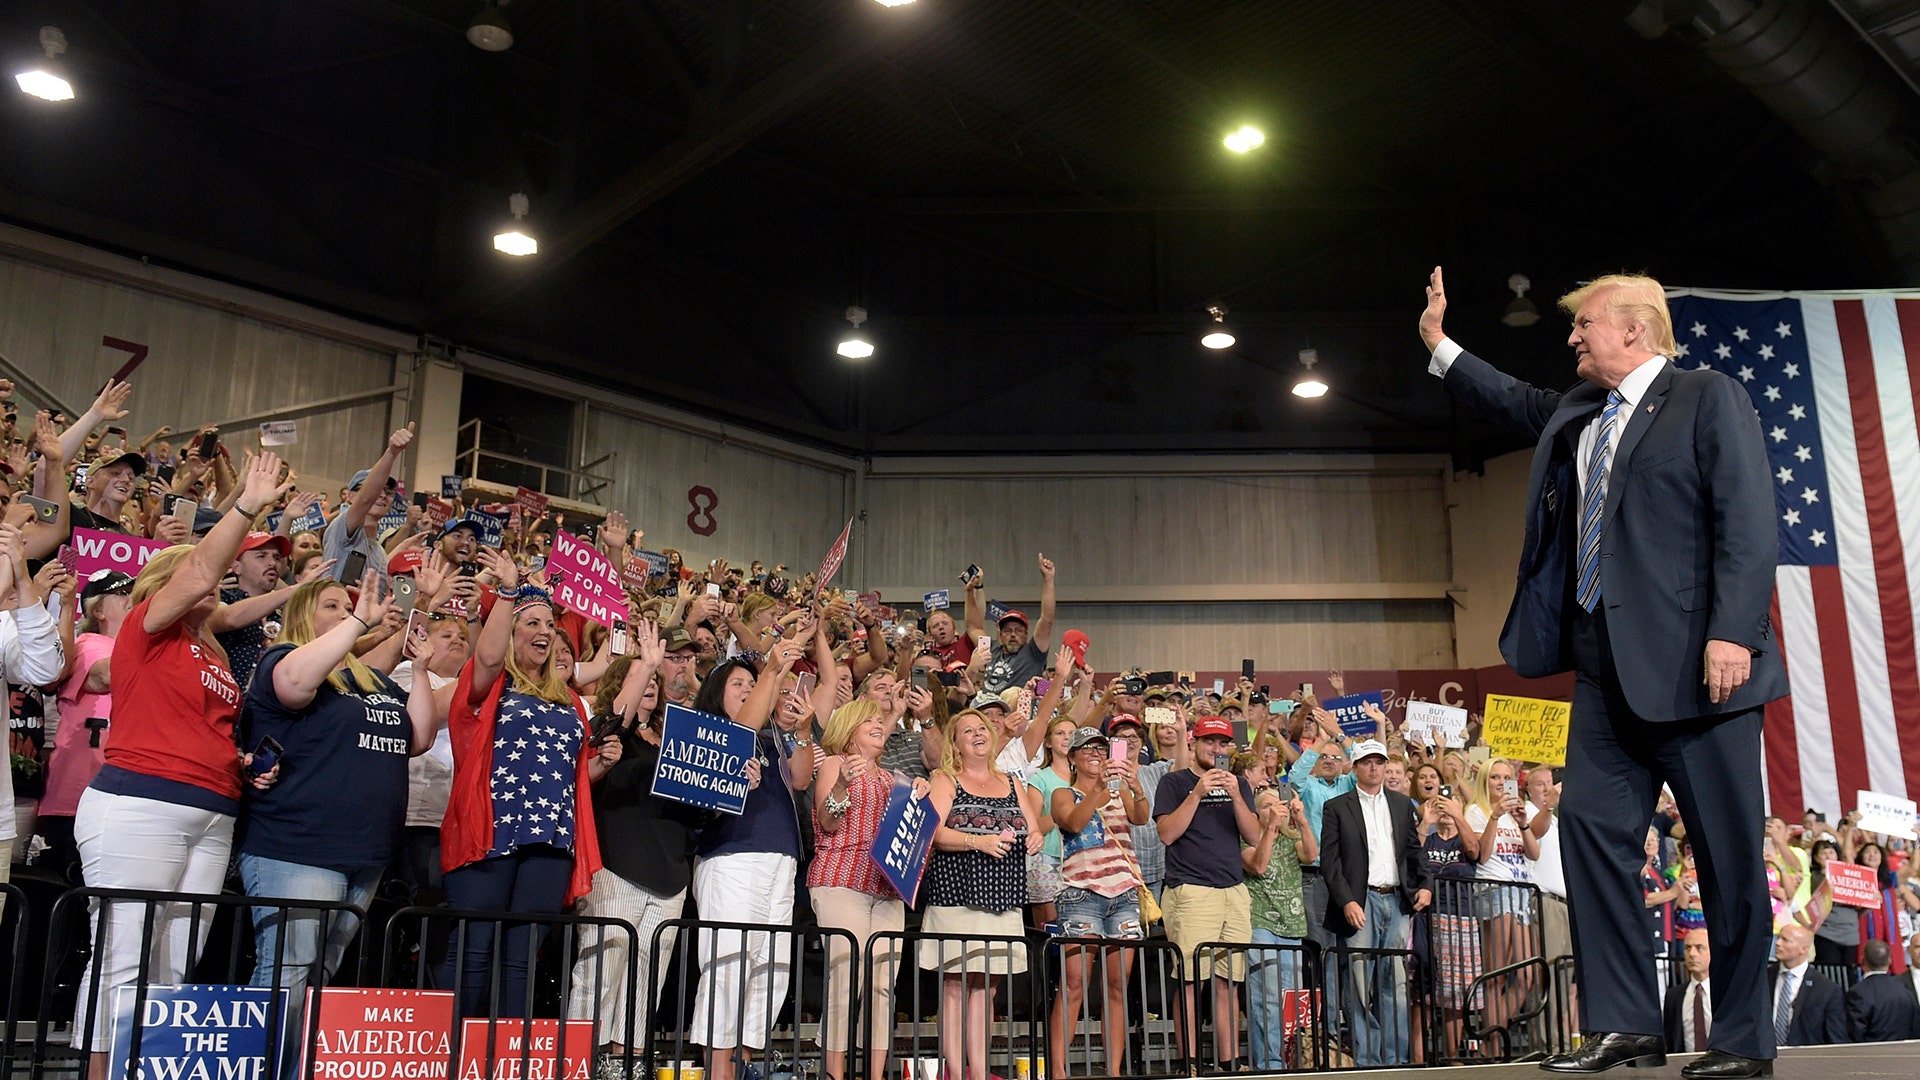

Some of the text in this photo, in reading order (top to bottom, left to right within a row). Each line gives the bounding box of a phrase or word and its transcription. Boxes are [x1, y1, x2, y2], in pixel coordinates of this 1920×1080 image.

[96, 335, 149, 396] 7
[687, 485, 718, 537] 8
[470, 513, 500, 530] DRAIN
[76, 534, 161, 566] WOM
[557, 534, 623, 590] WOME
[573, 571, 603, 598] FOR
[623, 570, 643, 582] AGAIN
[1439, 681, 1464, 708] C
[365, 706, 401, 725] LIVES
[1428, 707, 1446, 717] BUY
[1492, 698, 1539, 717] TRUMP
[1410, 712, 1462, 728] AMERICAN
[1426, 724, 1445, 733] HRE
[697, 726, 729, 747] MAKE
[1540, 722, 1565, 739] VET
[357, 732, 407, 754] MATTER
[1492, 735, 1521, 745] HOMES
[1528, 737, 1557, 748] APTS
[662, 738, 749, 779] AMERICA
[659, 763, 746, 798] STRONG AGAIN
[1865, 802, 1912, 816] TRUMP
[884, 788, 919, 868] TRUMP
[896, 805, 923, 872] PENCE
[1844, 868, 1863, 878] MAKE
[1830, 874, 1877, 893] AMERICA
[141, 999, 270, 1028] DRAIN
[364, 1007, 415, 1022] MAKE
[181, 1033, 229, 1052] THE
[315, 1029, 452, 1055] AMERICA
[313, 1061, 448, 1079] PROUD AGAIN
